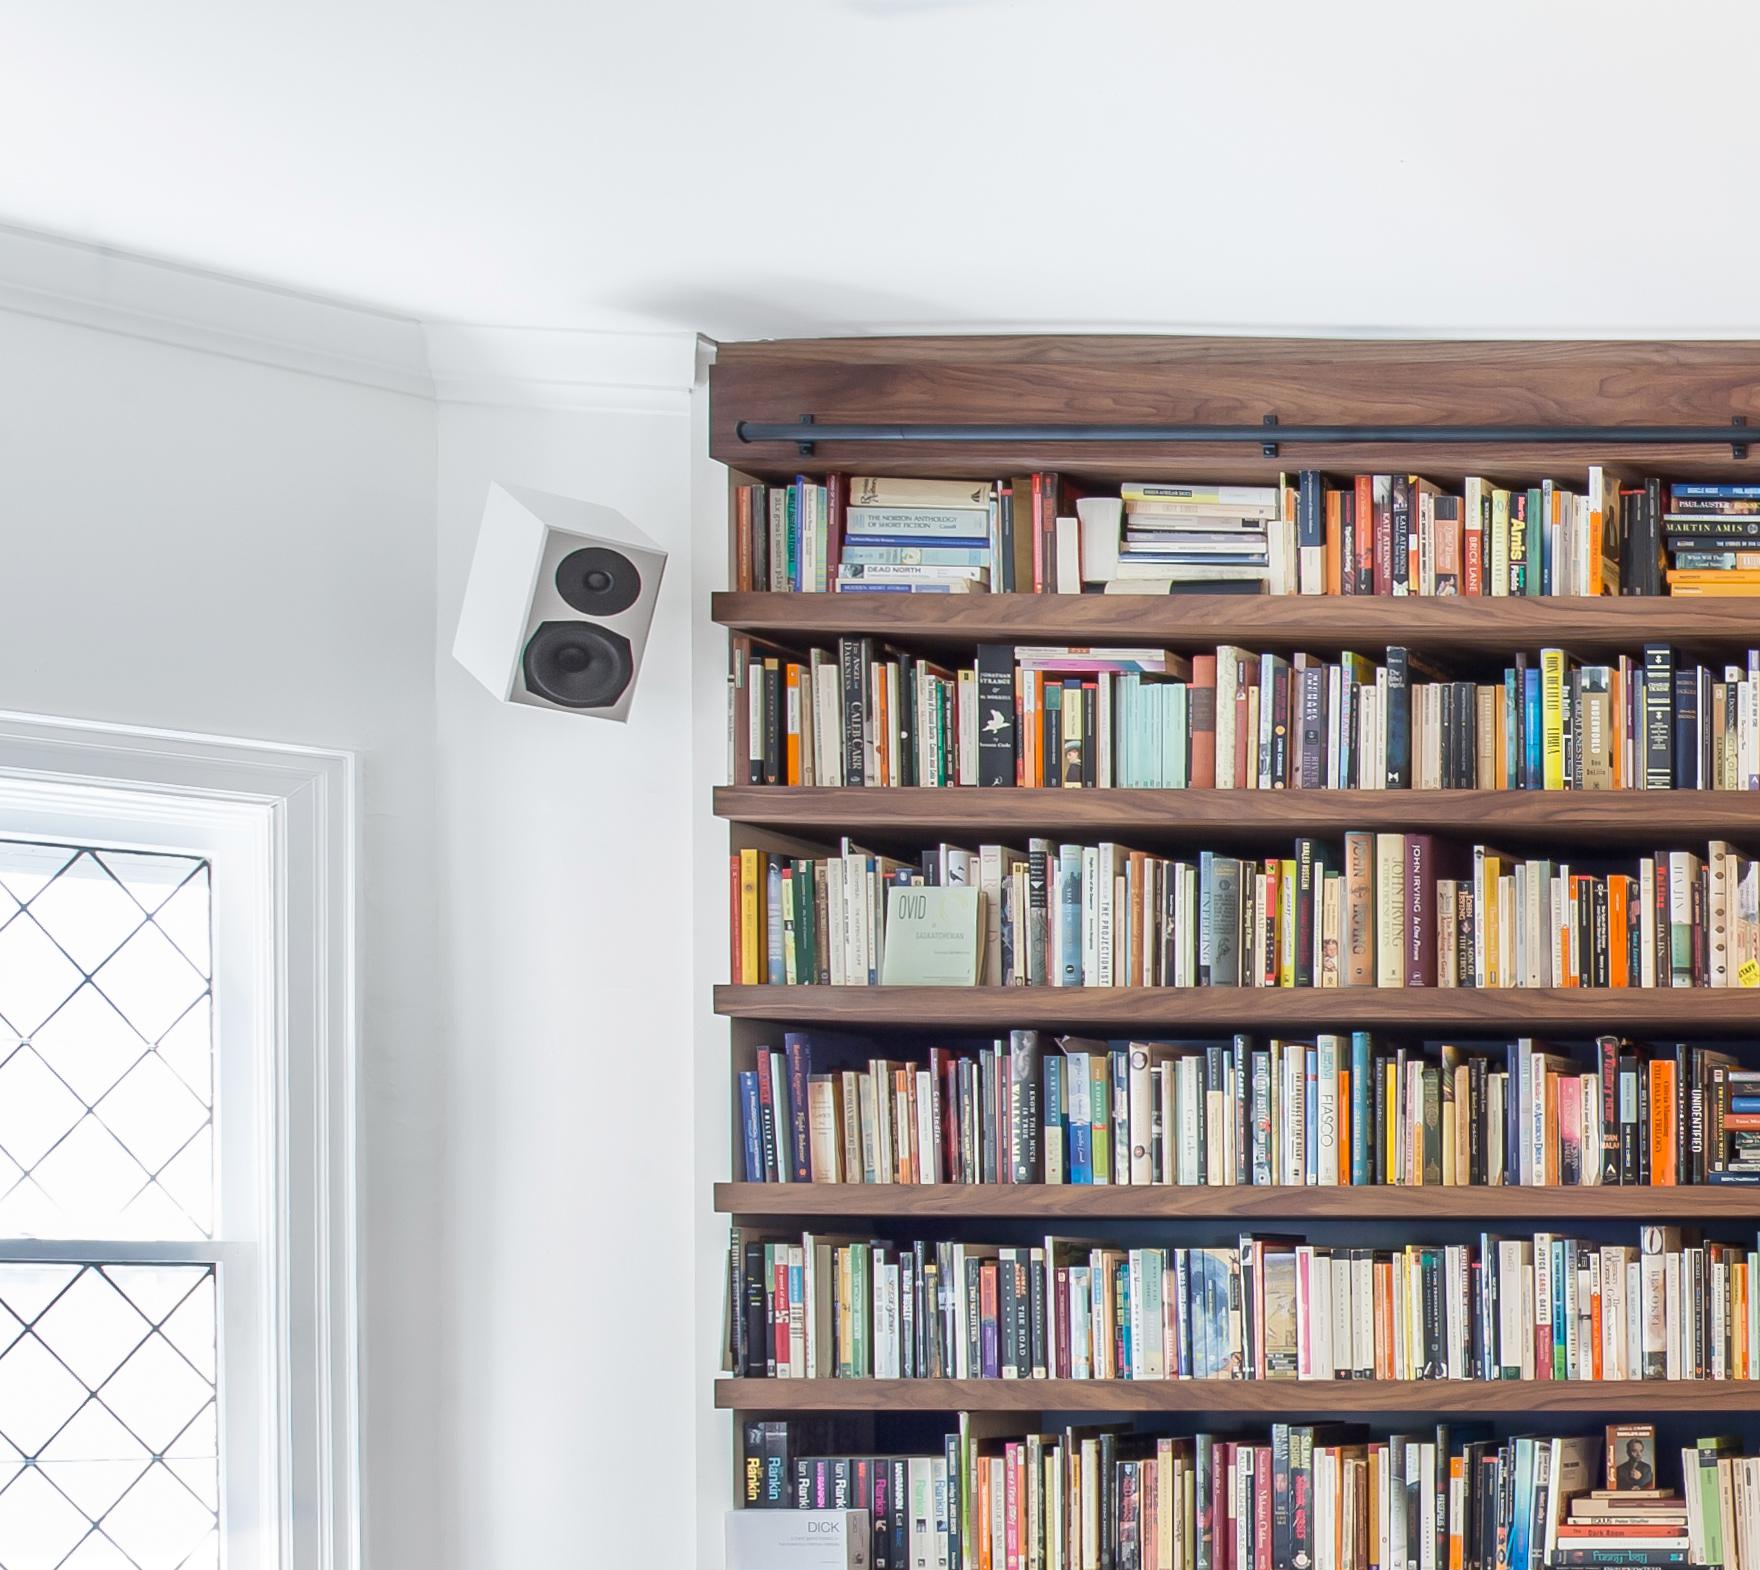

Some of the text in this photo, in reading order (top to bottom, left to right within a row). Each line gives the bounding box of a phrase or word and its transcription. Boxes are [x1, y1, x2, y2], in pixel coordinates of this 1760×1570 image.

[1399, 516, 1407, 574] KATE ATKINSON
[1510, 496, 1525, 560] Martin Amis
[1667, 524, 1742, 532] MARTIN AMIS
[1469, 537, 1478, 591] BRICK LANE
[851, 702, 862, 769] CALEB CARR
[1591, 700, 1600, 753] UNDERWORLD
[899, 896, 926, 919] OVID
[1100, 902, 1109, 984] THE PROJECTIONIST
[1691, 1090, 1702, 1152] UNIDENTIFIED
[1538, 1247, 1547, 1321] JOYCE CAROL OATES
[1017, 1306, 1027, 1356] THE ROAD
[747, 1458, 760, 1500] Rankin
[769, 1457, 781, 1499] Rankin
[875, 1480, 886, 1517] Rankin
[916, 1480, 927, 1516] Rankin
[936, 1480, 946, 1517] Rankin
[808, 1521, 840, 1533] DICK
